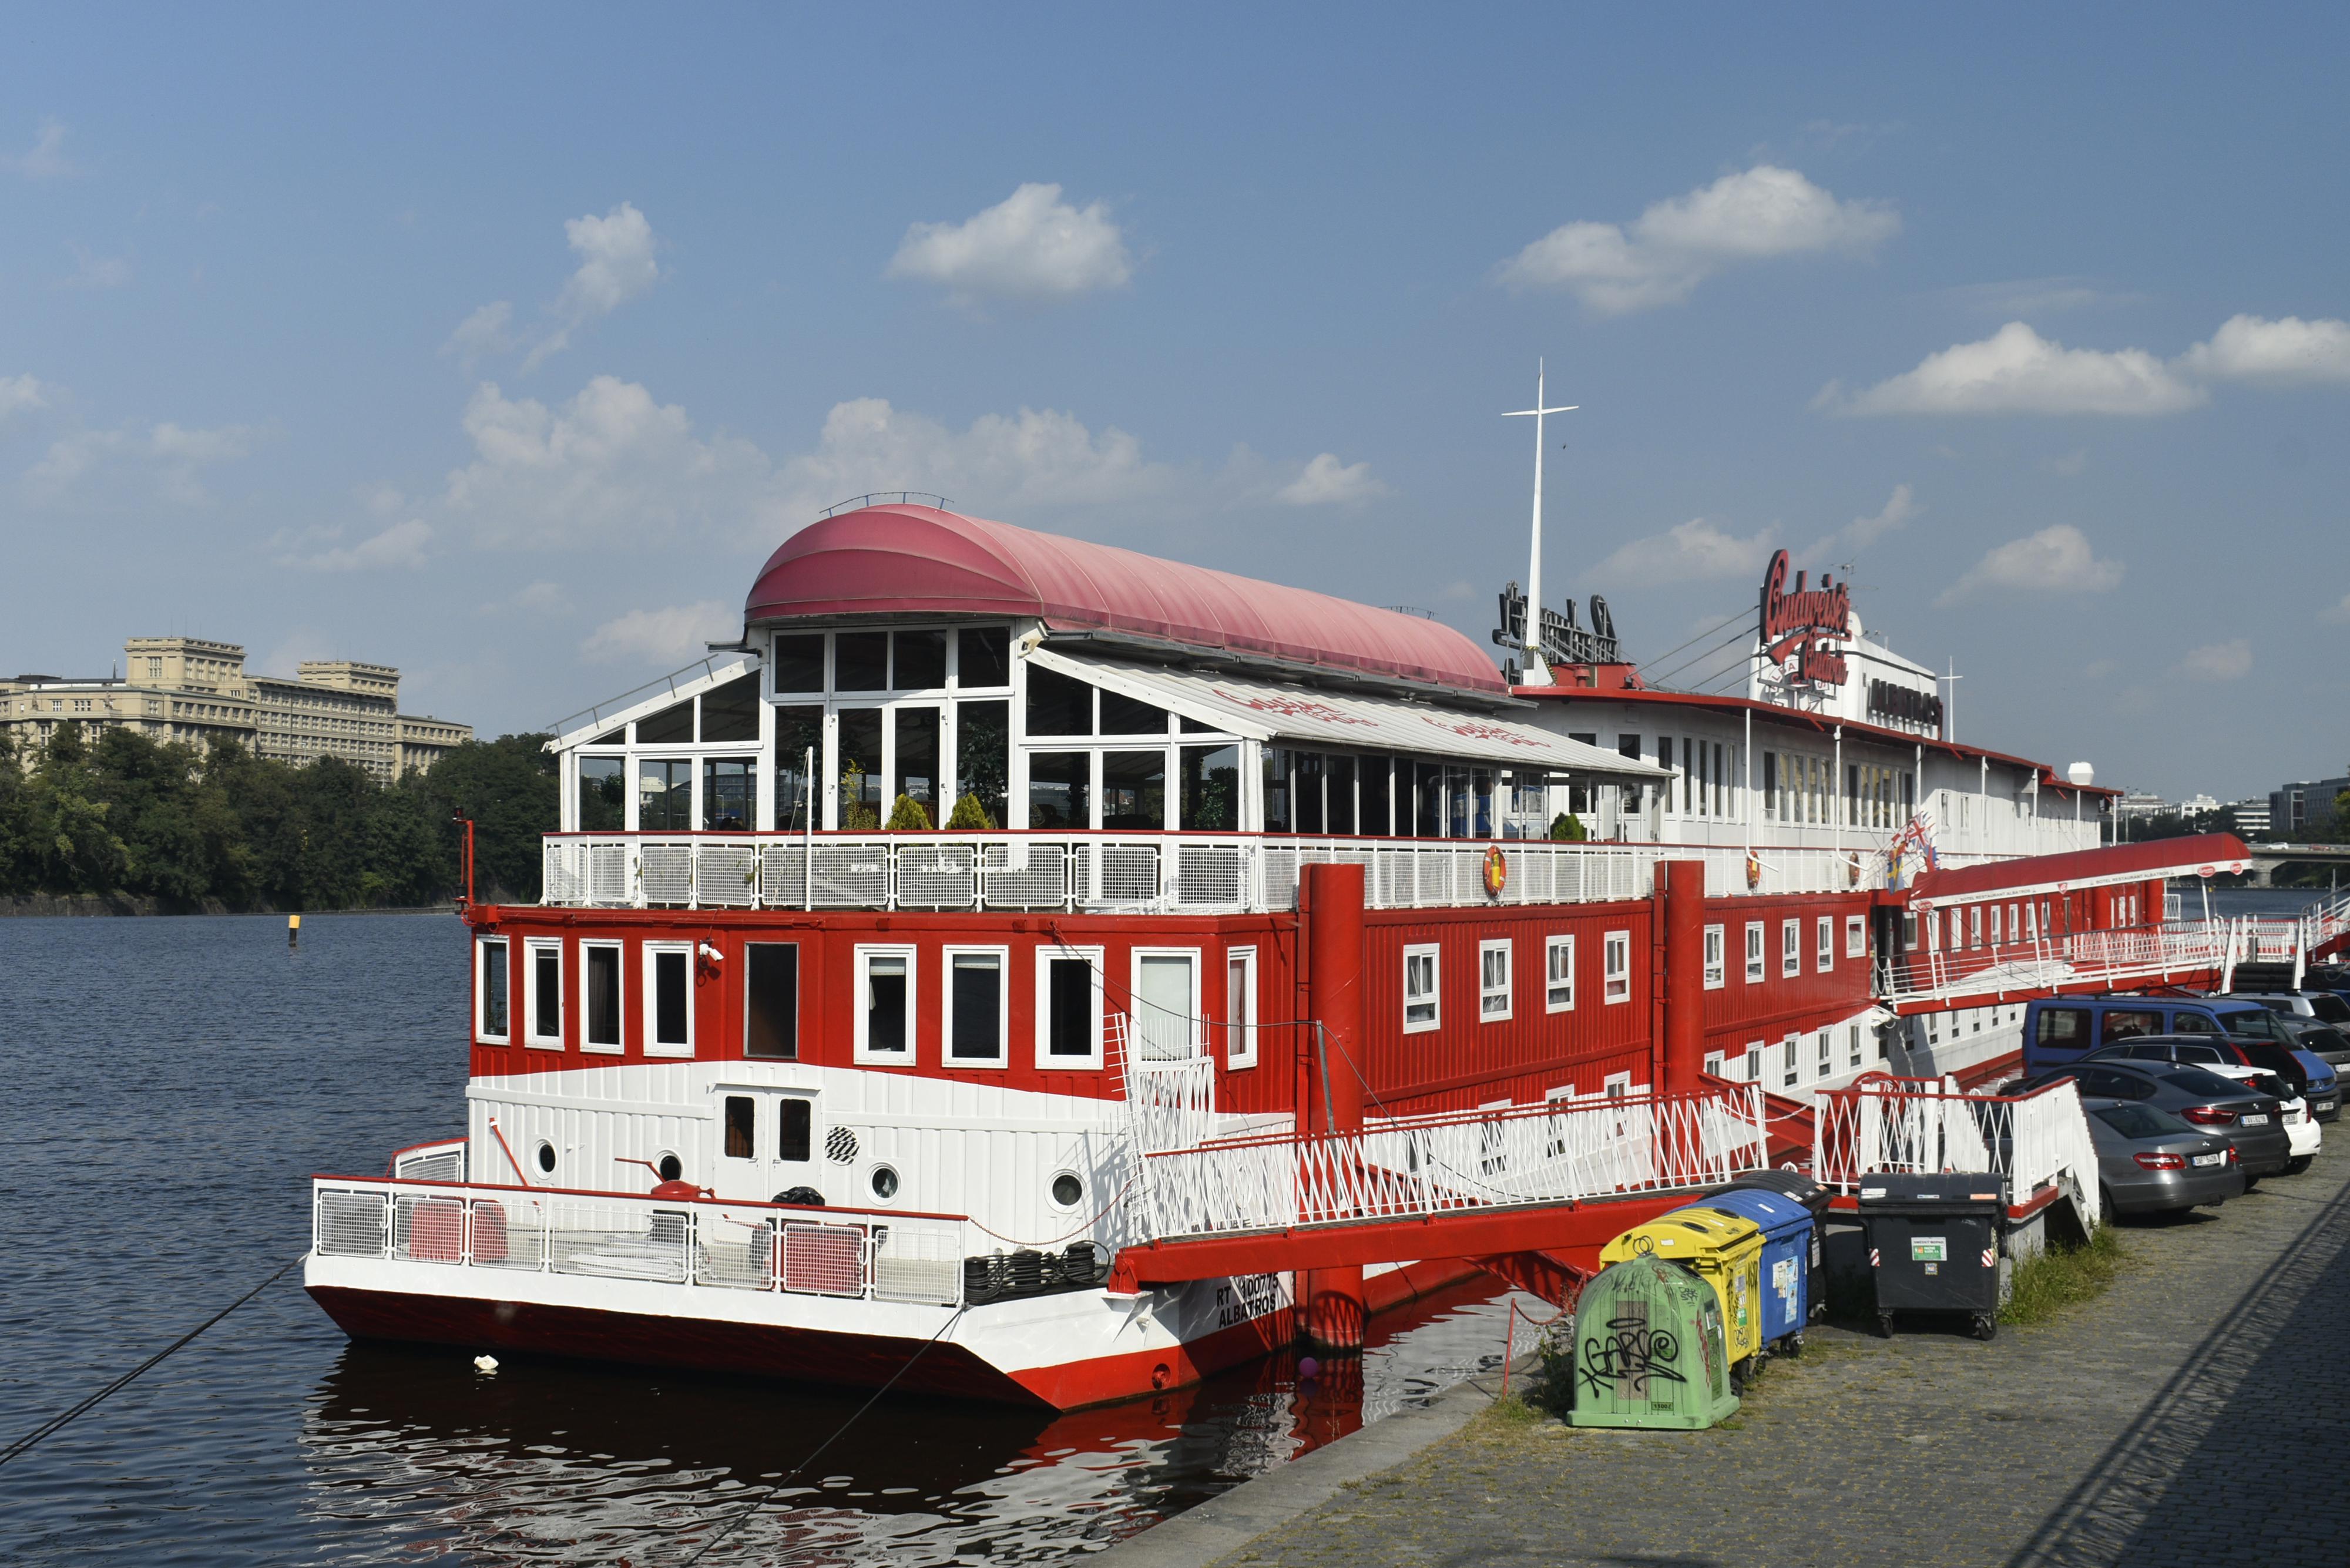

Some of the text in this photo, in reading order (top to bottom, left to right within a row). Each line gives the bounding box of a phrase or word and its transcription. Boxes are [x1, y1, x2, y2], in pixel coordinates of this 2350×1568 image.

[1217, 1272, 1279, 1307] RT 100775
[1218, 1293, 1276, 1329] ALBATROS
